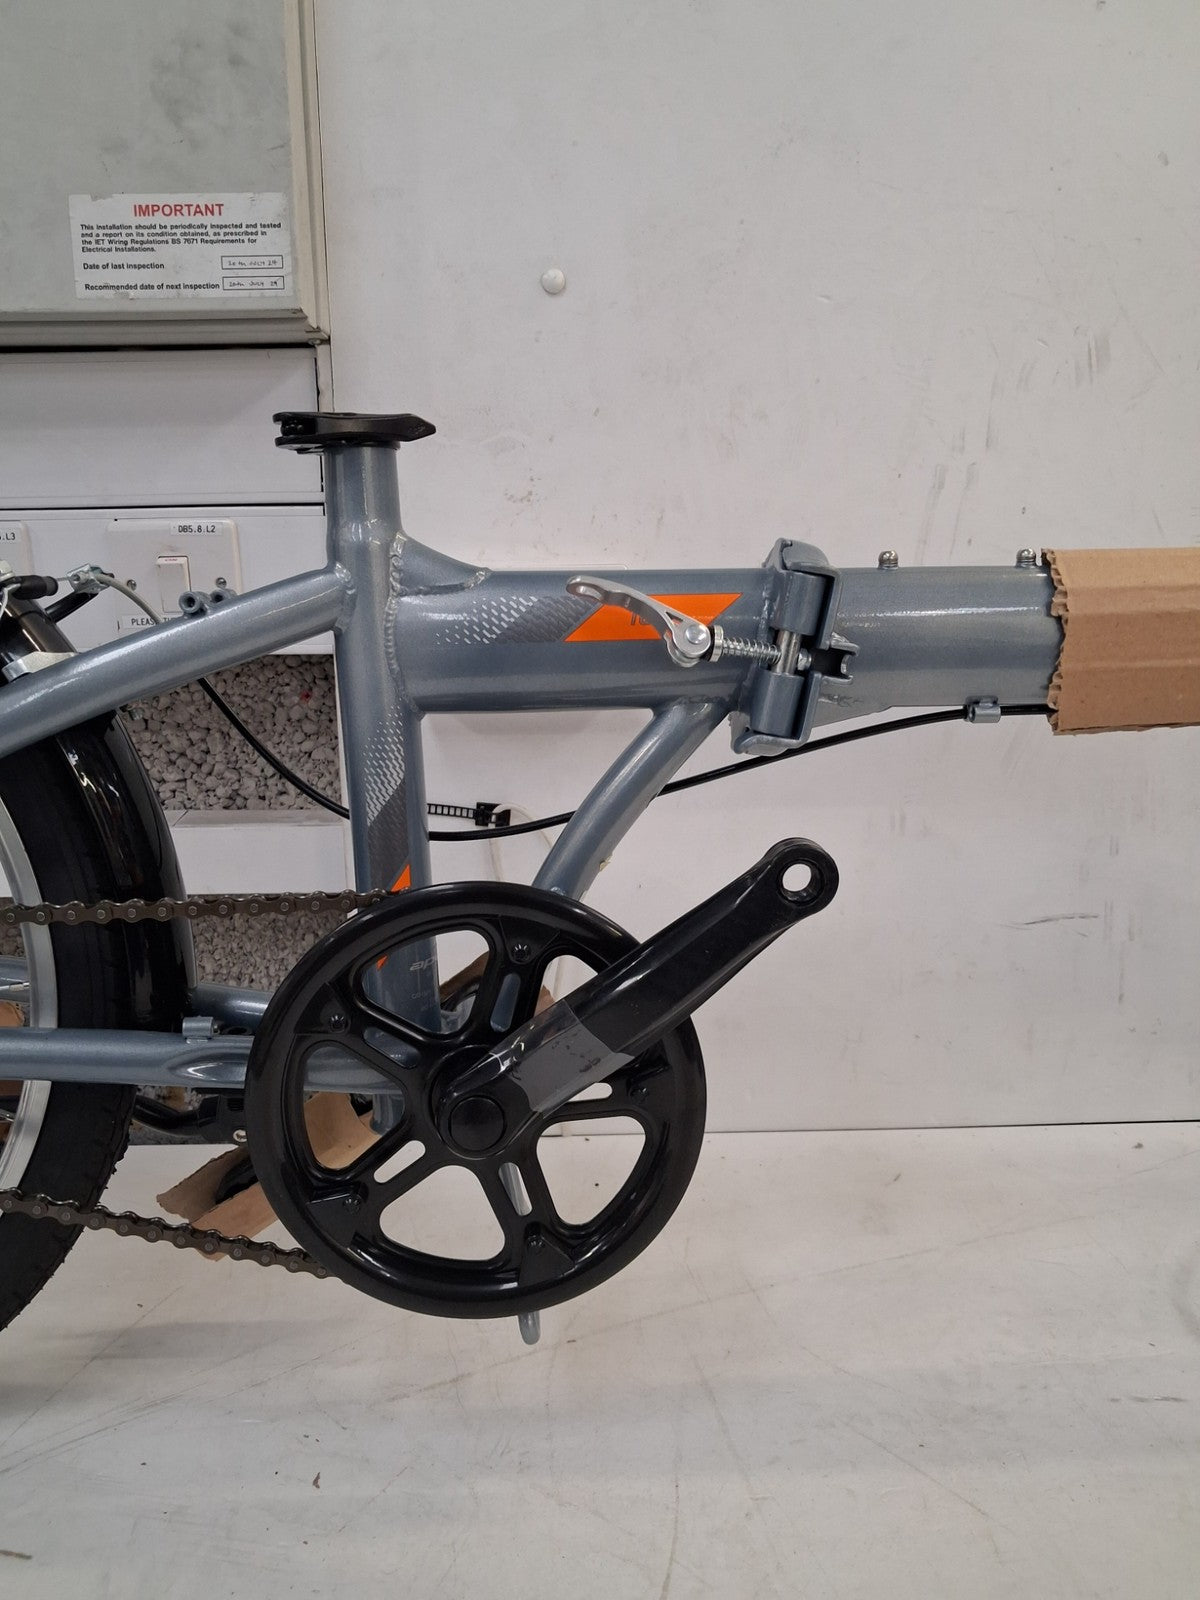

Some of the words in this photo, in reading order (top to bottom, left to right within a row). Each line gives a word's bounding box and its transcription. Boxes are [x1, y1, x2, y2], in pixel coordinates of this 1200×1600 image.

[133, 204, 224, 217] IMPORTANT
[170, 223, 207, 231] periodically
[210, 222, 243, 230] inspected
[223, 230, 258, 238] prescribed
[130, 238, 169, 246] Regulations
[200, 237, 245, 245] Requirements
[126, 262, 164, 270] inspection
[183, 282, 220, 291] inspection
[0, 532, 16, 541] .L3
[131, 617, 160, 626] PLEAS
